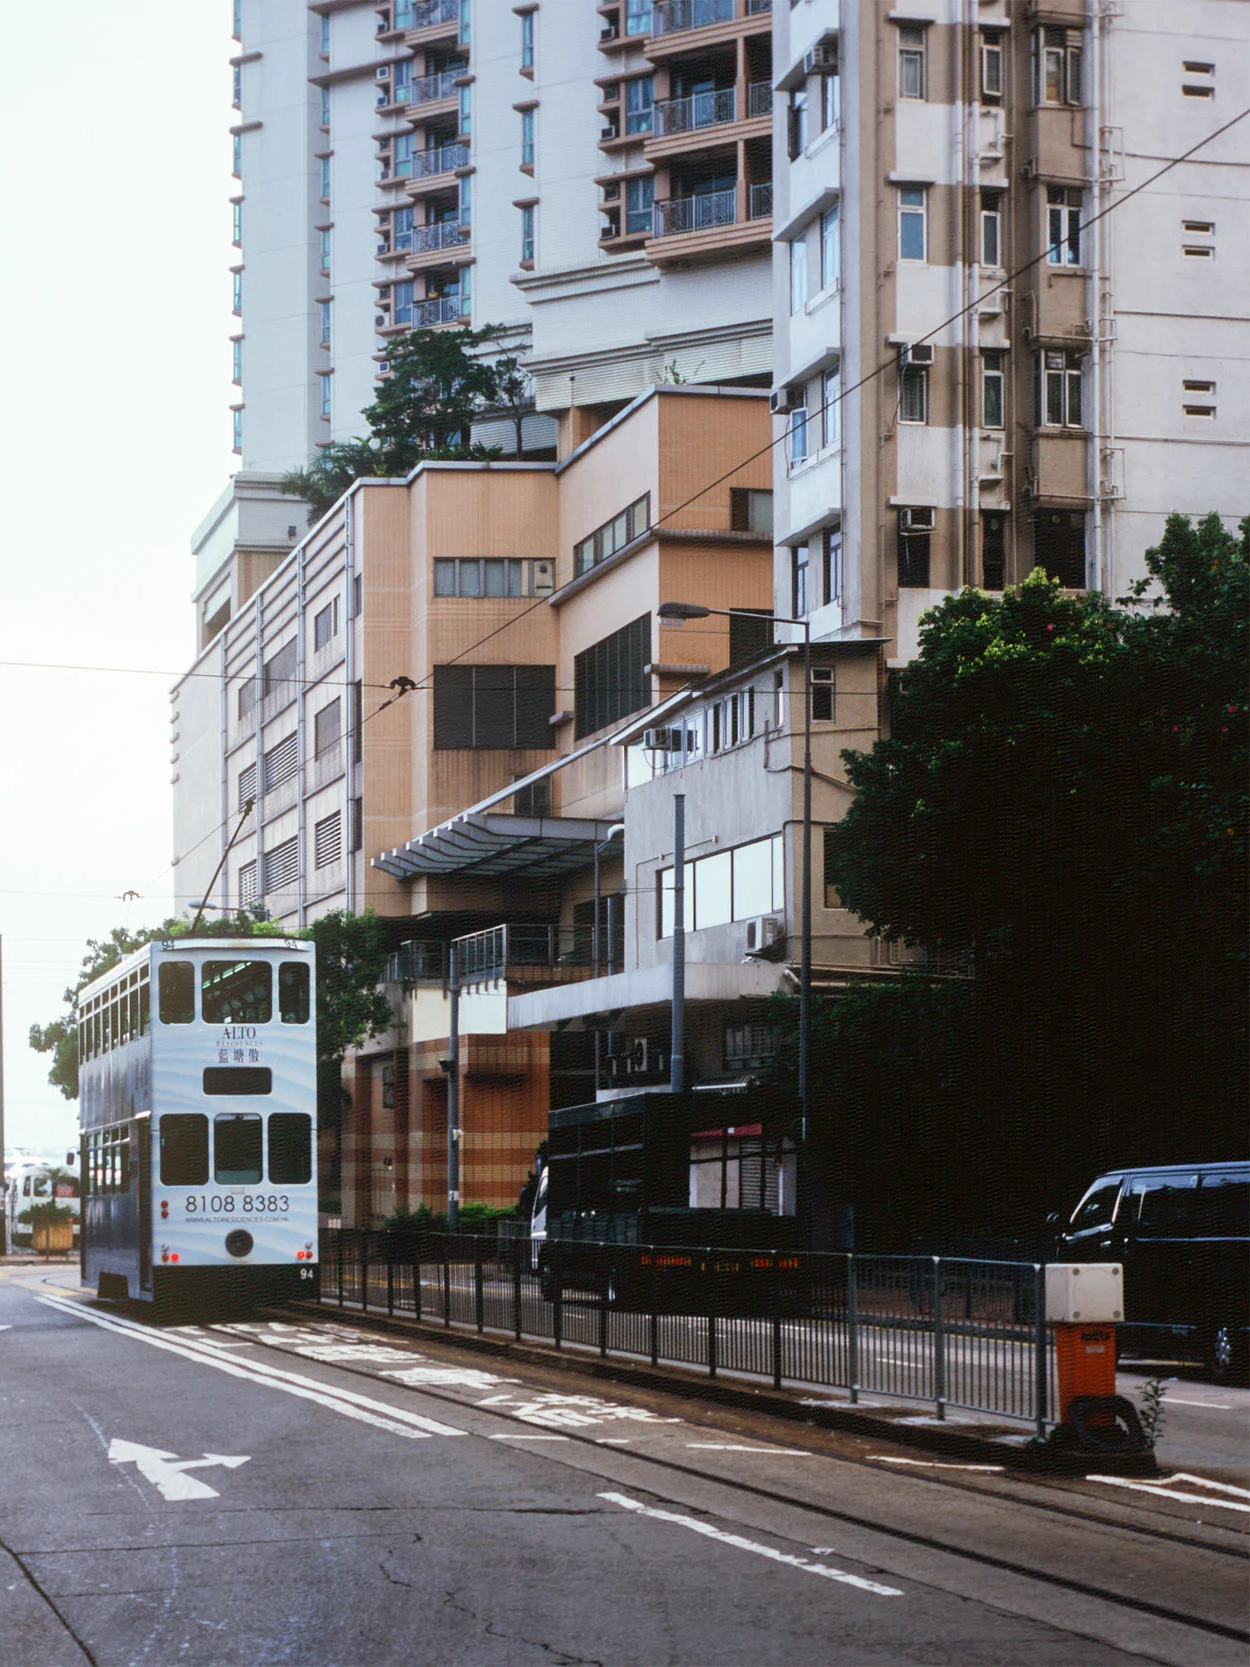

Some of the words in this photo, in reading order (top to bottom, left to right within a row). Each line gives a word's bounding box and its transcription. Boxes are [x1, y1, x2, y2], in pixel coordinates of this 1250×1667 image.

[222, 1026, 256, 1040] ALTO
[185, 1195, 235, 1213] 8108
[242, 1195, 289, 1212] 8383
[300, 1268, 313, 1280] 94
